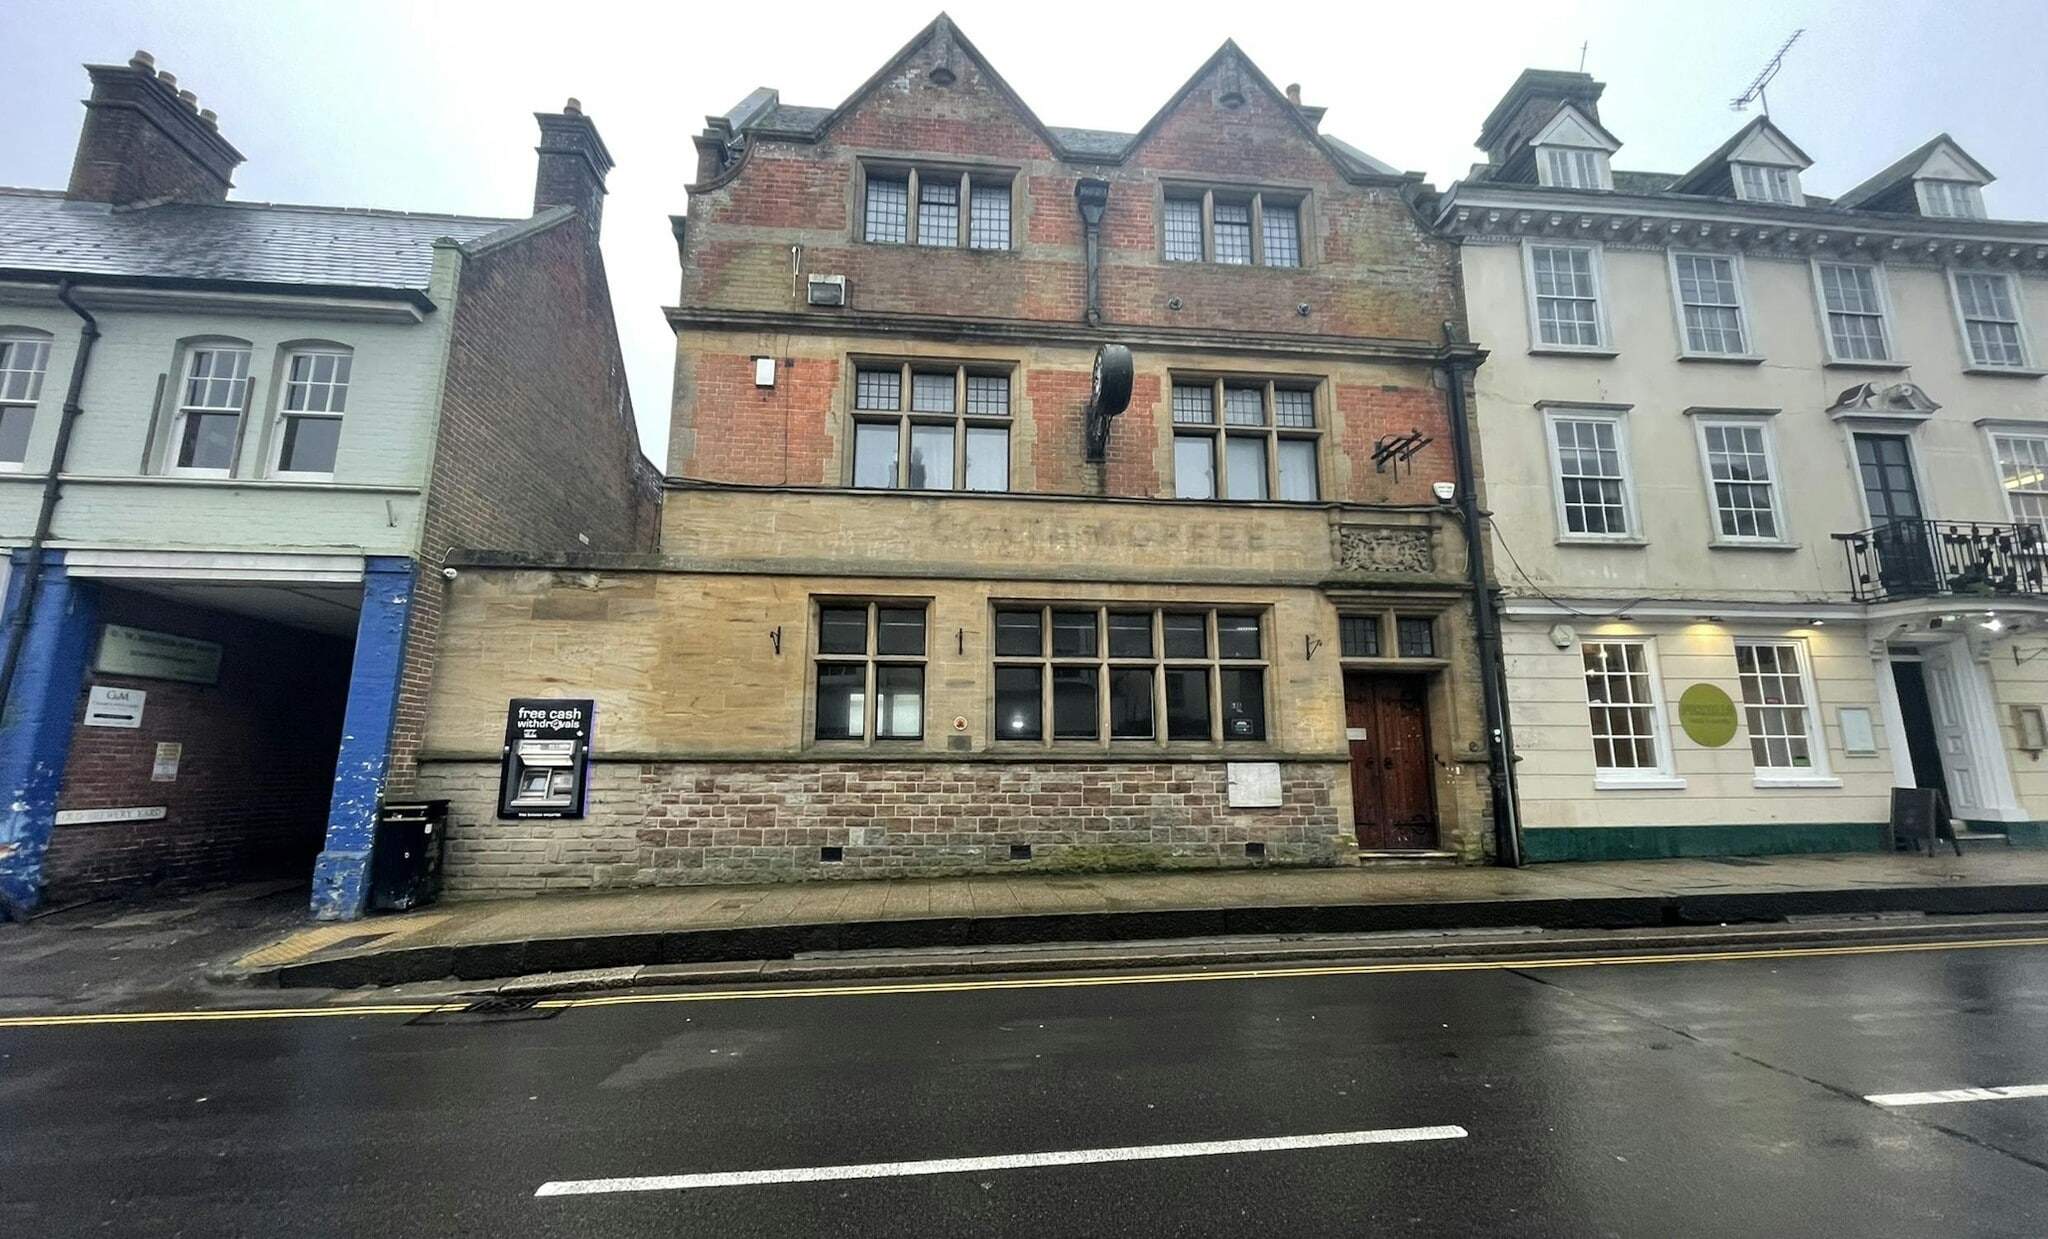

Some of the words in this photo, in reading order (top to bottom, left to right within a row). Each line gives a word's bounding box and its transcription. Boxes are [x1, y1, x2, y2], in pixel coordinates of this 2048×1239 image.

[518, 707, 547, 719] free
[549, 708, 582, 719] cash
[137, 807, 161, 818] YARD
